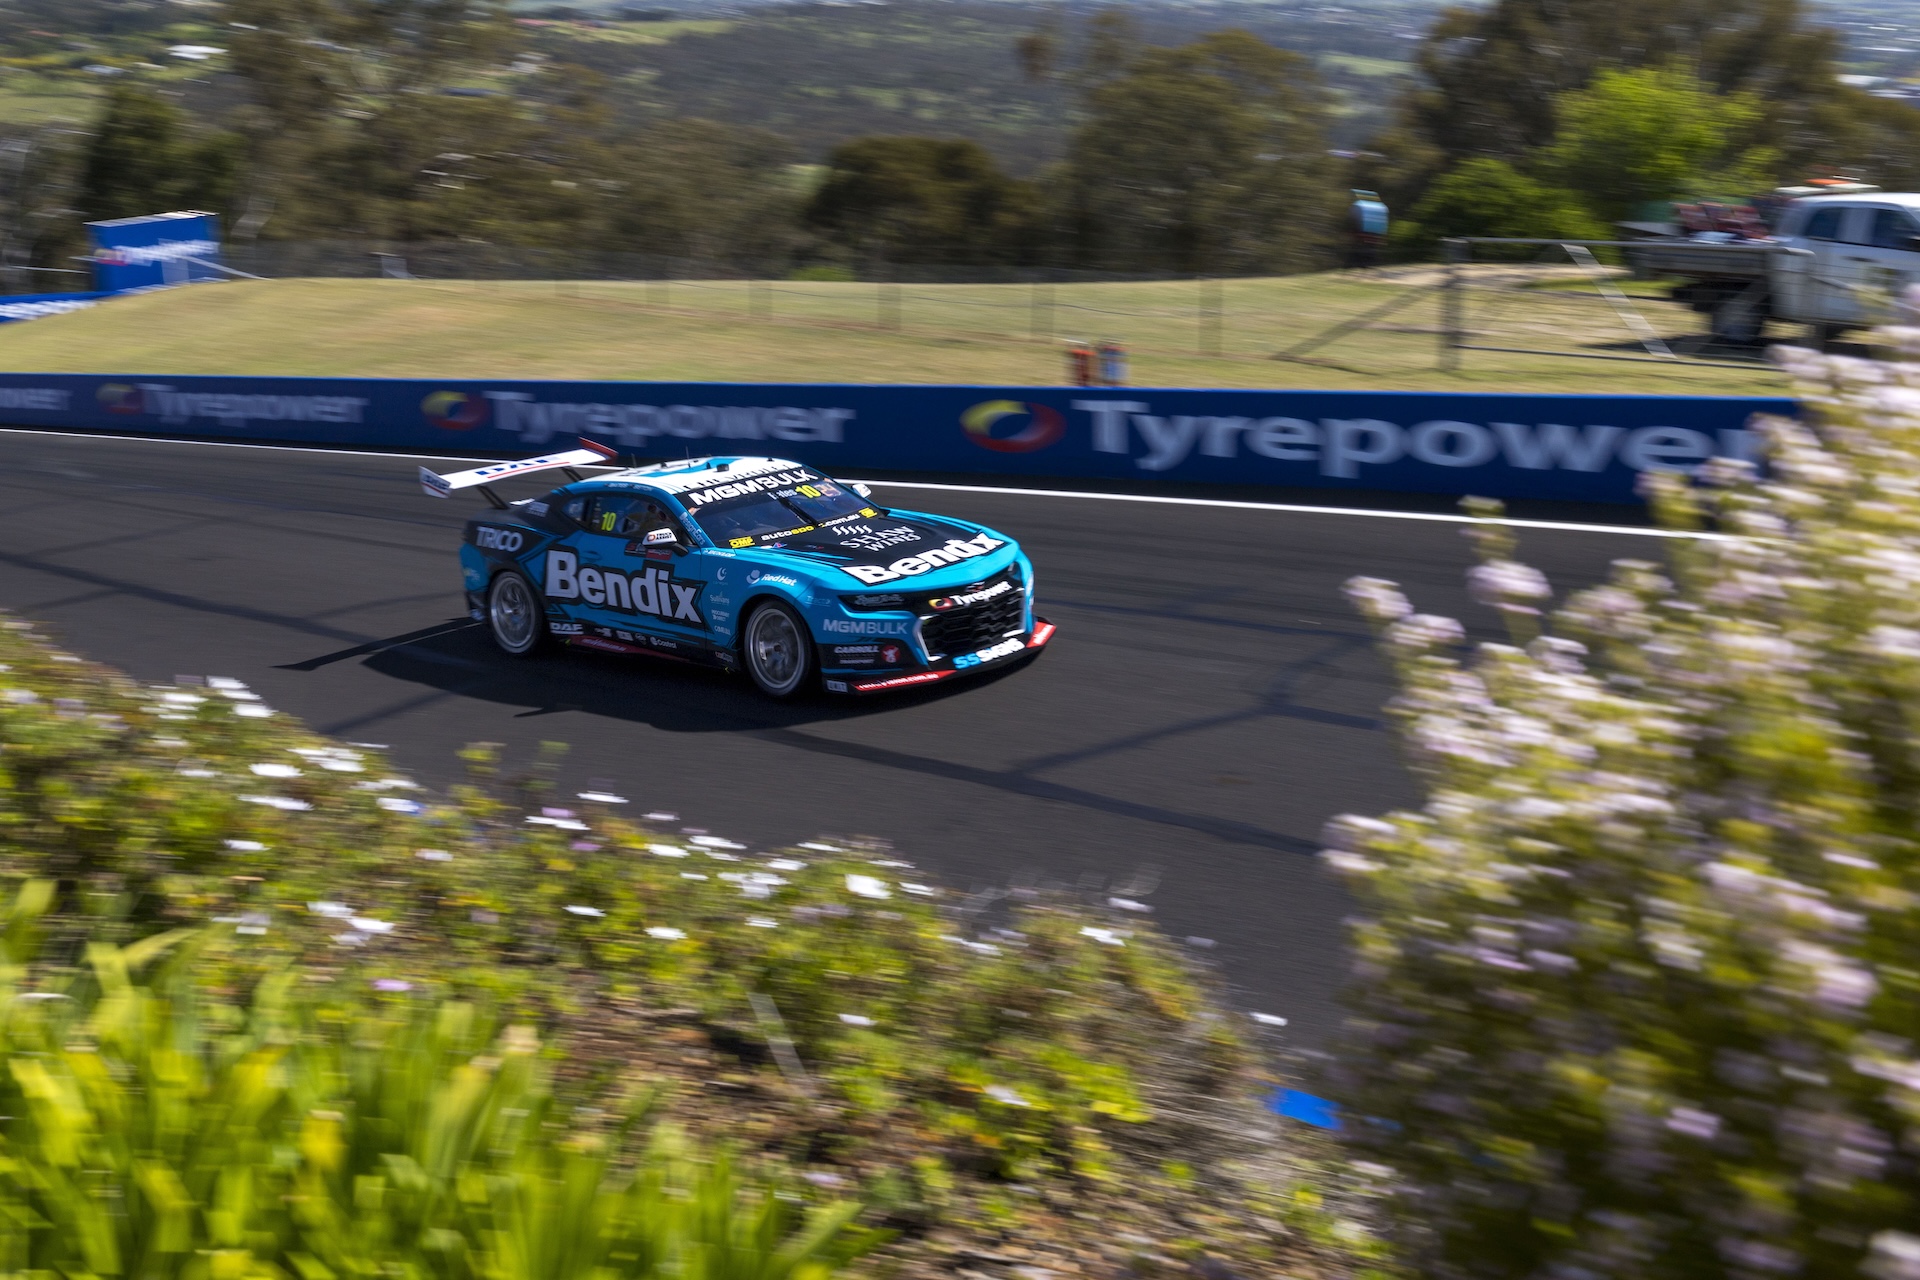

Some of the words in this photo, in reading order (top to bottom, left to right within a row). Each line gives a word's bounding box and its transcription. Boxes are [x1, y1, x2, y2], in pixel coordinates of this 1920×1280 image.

[134, 382, 368, 427] Tyrepower
[483, 391, 855, 446] Tyrepower
[688, 469, 818, 505] MGMBULK
[795, 484, 821, 499] 10
[601, 511, 617, 531] 10
[476, 526, 523, 552] TRICO
[729, 537, 754, 548] OMP
[840, 526, 914, 548] SHAW
[864, 533, 921, 551] WINES
[840, 532, 1004, 583] Bendix
[545, 550, 702, 623] Bendix
[761, 573, 779, 583] Red
[778, 575, 798, 587] Hat
[949, 581, 1013, 607] Tyrepower
[550, 623, 583, 632] DAF
[823, 619, 908, 635] MGMBULK
[657, 638, 677, 649] Castrol
[834, 645, 879, 654] CARROLL
